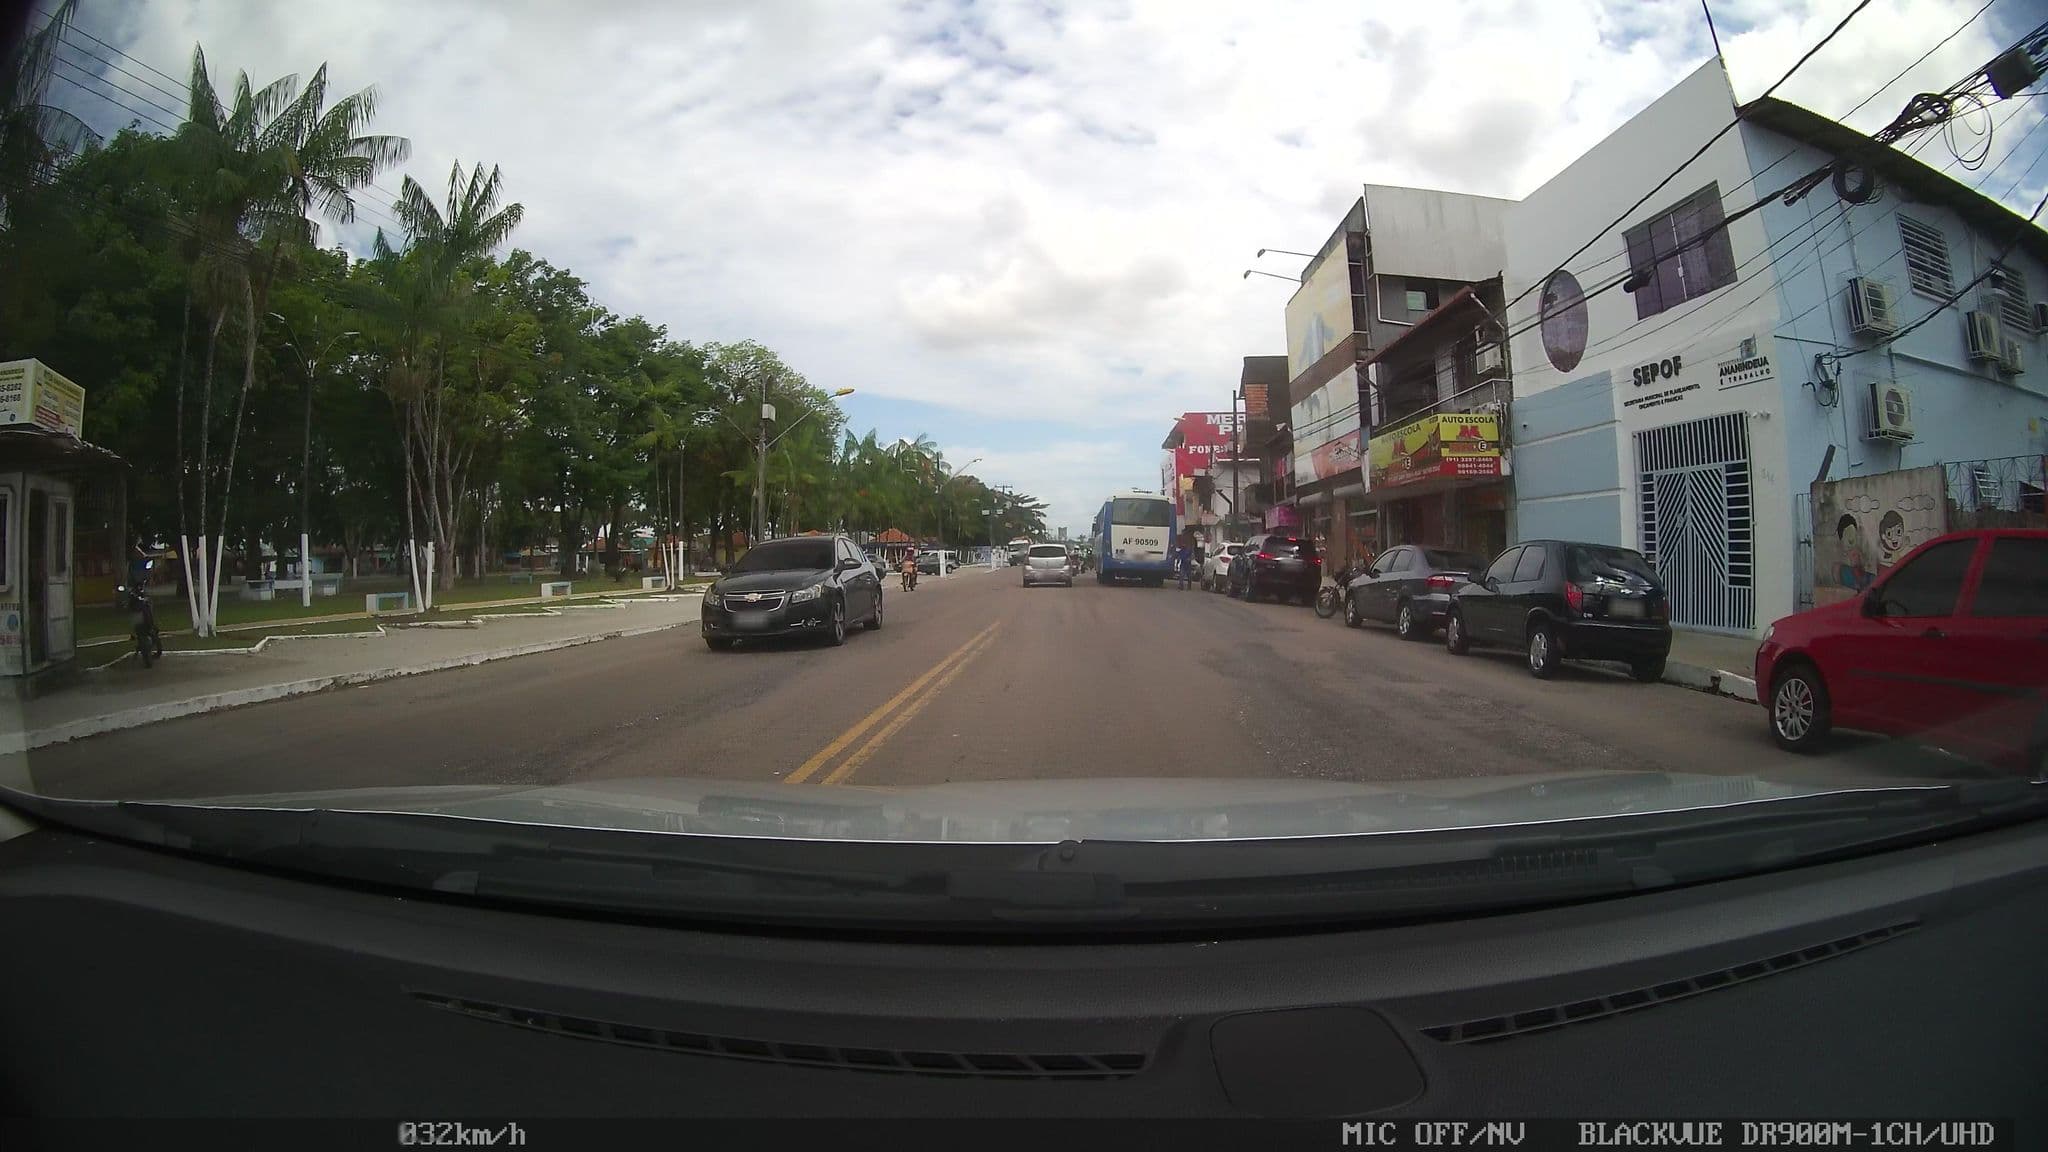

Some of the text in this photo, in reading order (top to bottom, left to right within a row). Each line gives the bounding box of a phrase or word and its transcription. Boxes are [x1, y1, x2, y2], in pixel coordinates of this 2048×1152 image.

[1632, 355, 1683, 387] SEPOF
[1719, 356, 1769, 377] ANANINDEUA
[1728, 368, 1771, 384] TRABALHO
[1442, 416, 1464, 424] AUTO
[1465, 416, 1495, 424] ESCOLA
[1122, 537, 1159, 546] AF 90509
